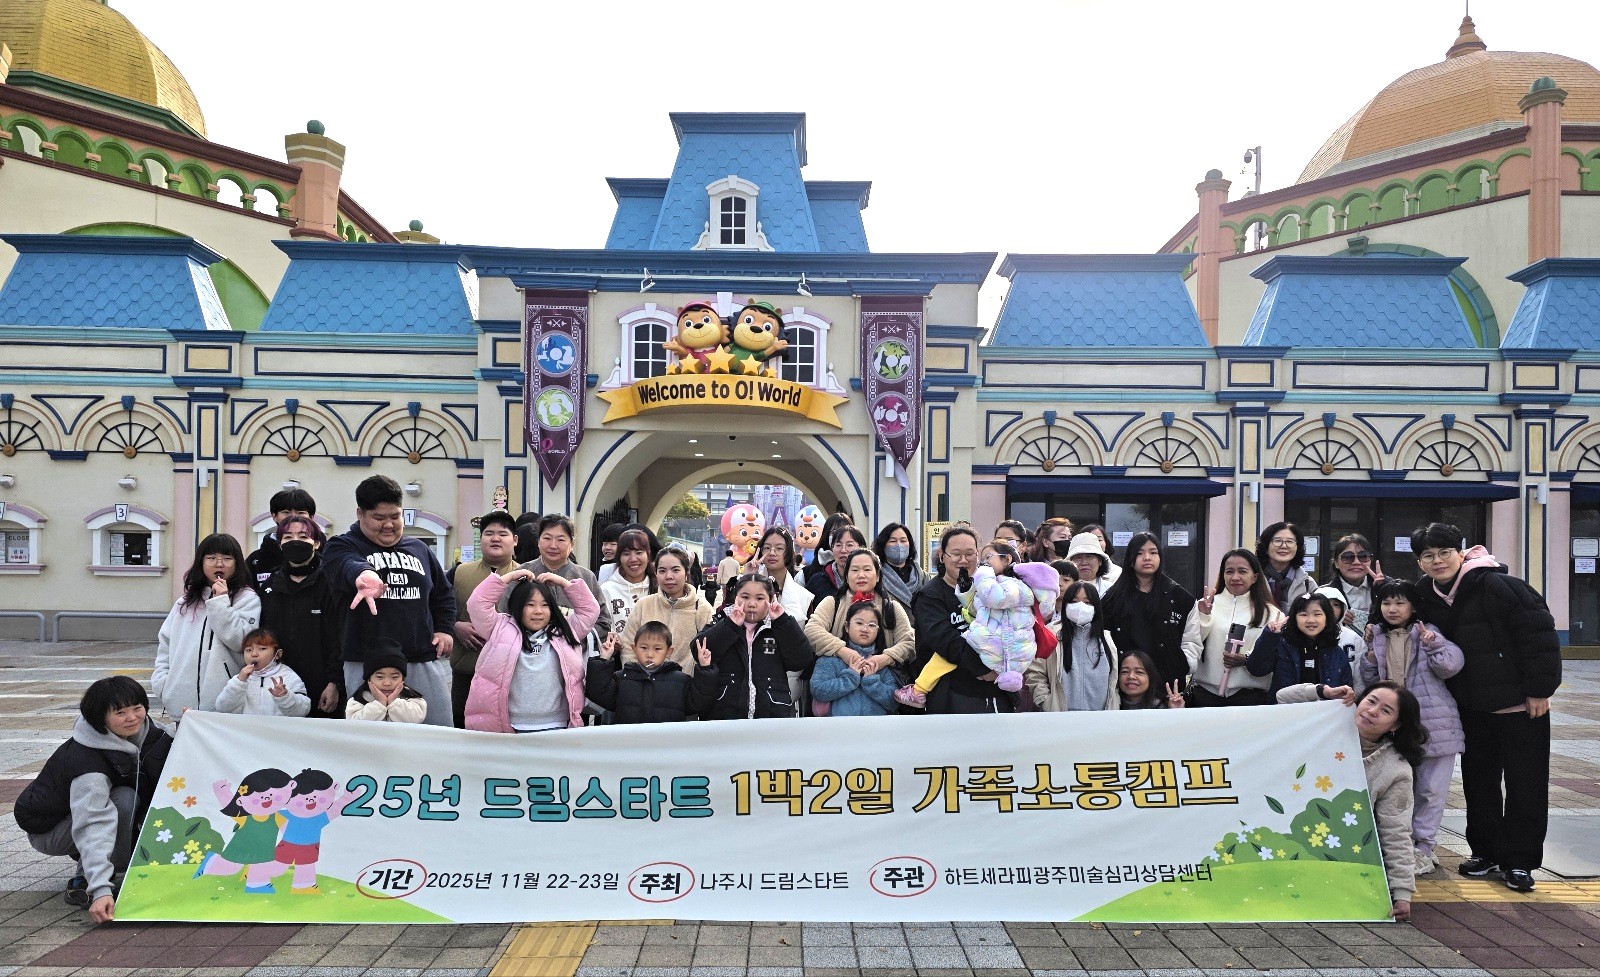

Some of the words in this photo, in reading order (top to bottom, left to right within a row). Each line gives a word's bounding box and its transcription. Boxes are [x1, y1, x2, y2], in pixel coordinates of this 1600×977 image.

[638, 382, 706, 404] Welcome
[711, 380, 730, 399] to
[735, 380, 754, 400] O!
[758, 381, 801, 407] World
[118, 507, 125, 518] 3
[406, 512, 411, 523] 1
[341, 773, 462, 821] 25년
[480, 775, 714, 822] 드림스타트
[730, 767, 895, 817] 1박2일
[911, 757, 1239, 814] 가족소통캠프
[368, 868, 414, 890] 기간
[426, 872, 493, 890] 2025년
[501, 872, 540, 890] 11월
[546, 872, 619, 890] 22-23일
[639, 872, 681, 895] 주최
[700, 872, 753, 891] 나주시
[760, 871, 850, 890] 드림스타트
[883, 865, 925, 889] 주관
[944, 863, 1213, 886] 하트세라피광주미술심리상담센터
